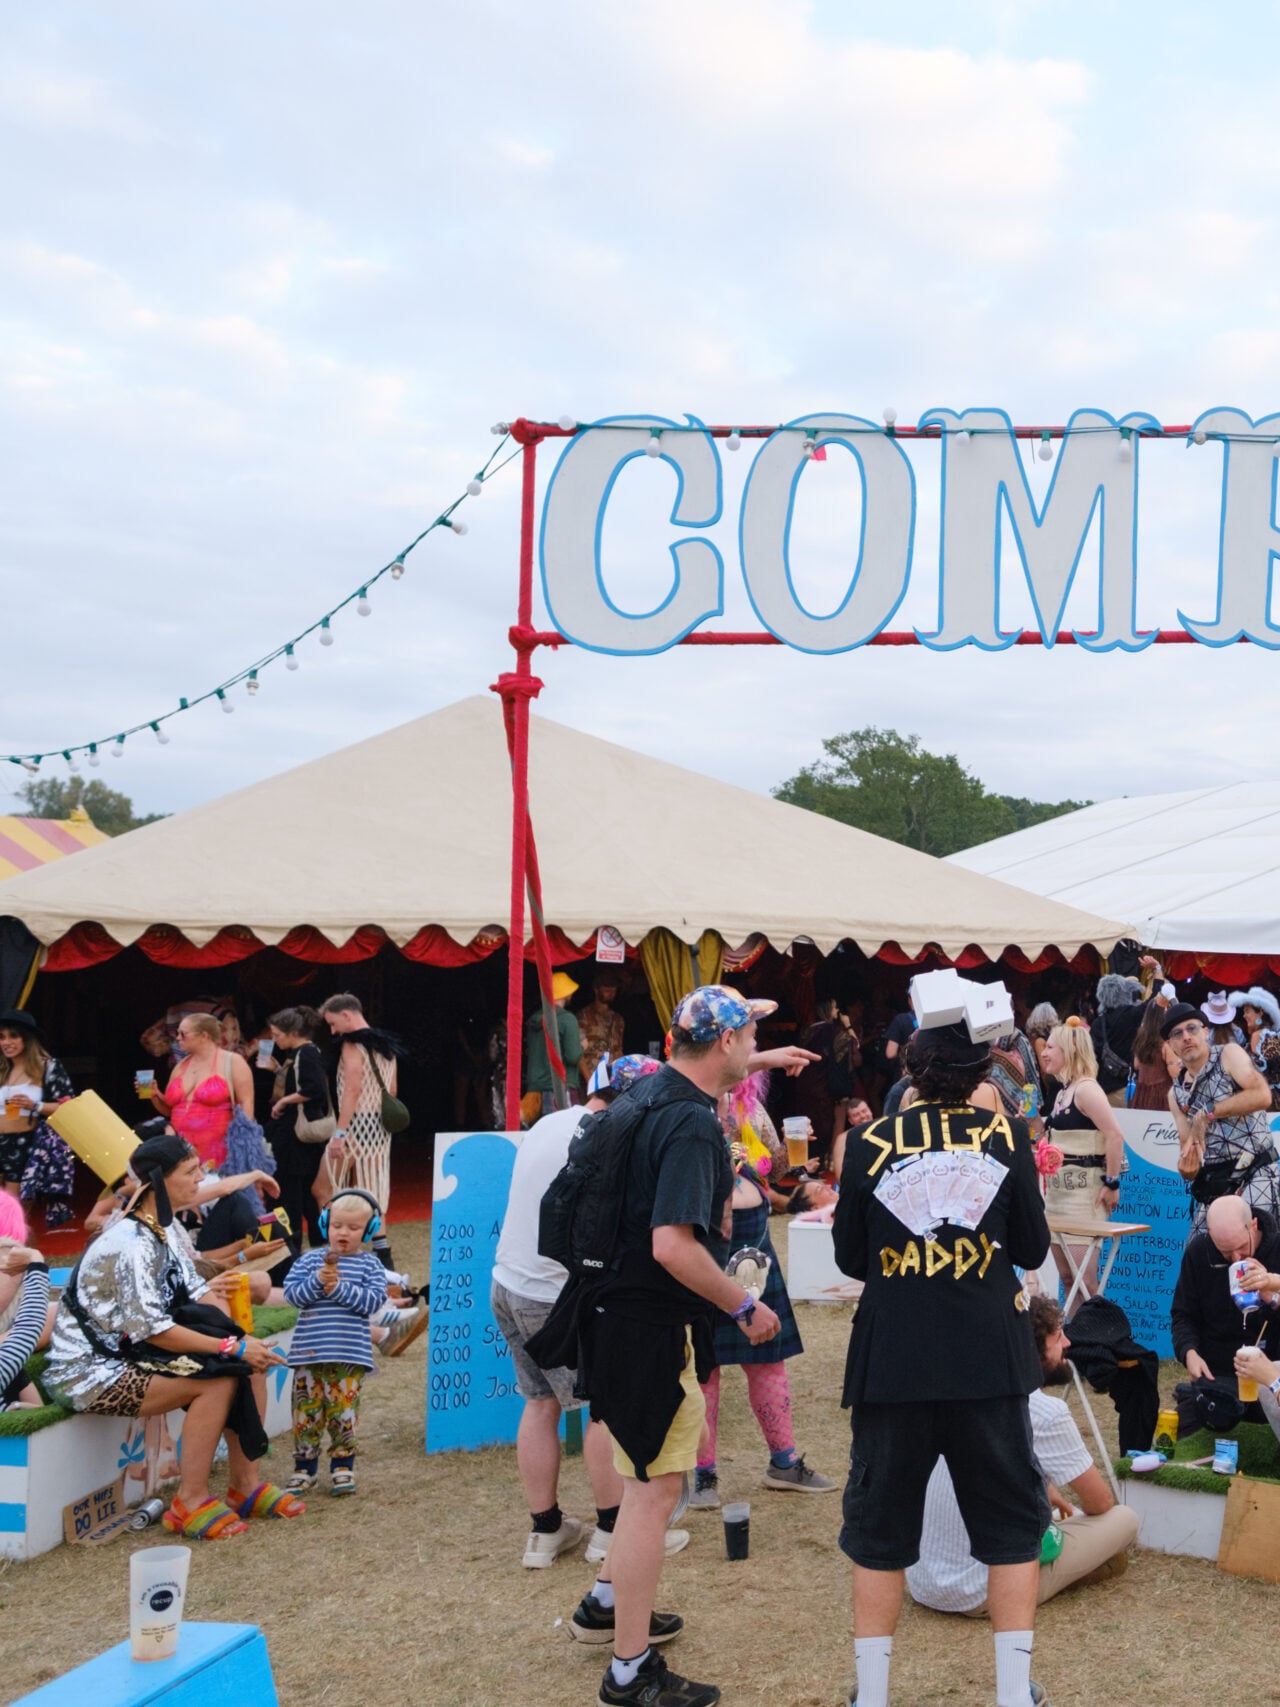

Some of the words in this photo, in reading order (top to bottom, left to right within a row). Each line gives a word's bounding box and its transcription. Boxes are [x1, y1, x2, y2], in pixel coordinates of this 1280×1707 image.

[861, 1108, 1015, 1176] SUGA
[1112, 1203, 1161, 1218] MINTON
[1112, 1235, 1185, 1251] LITTERBOSH
[582, 1258, 604, 1268] evoc
[880, 1232, 1001, 1280] DADDY
[1144, 1251, 1172, 1267] DIPS
[1136, 1266, 1165, 1281] WIFE
[1123, 1296, 1159, 1311] SALAD
[75, 1512, 91, 1535] DO
[97, 1501, 117, 1522] LIE
